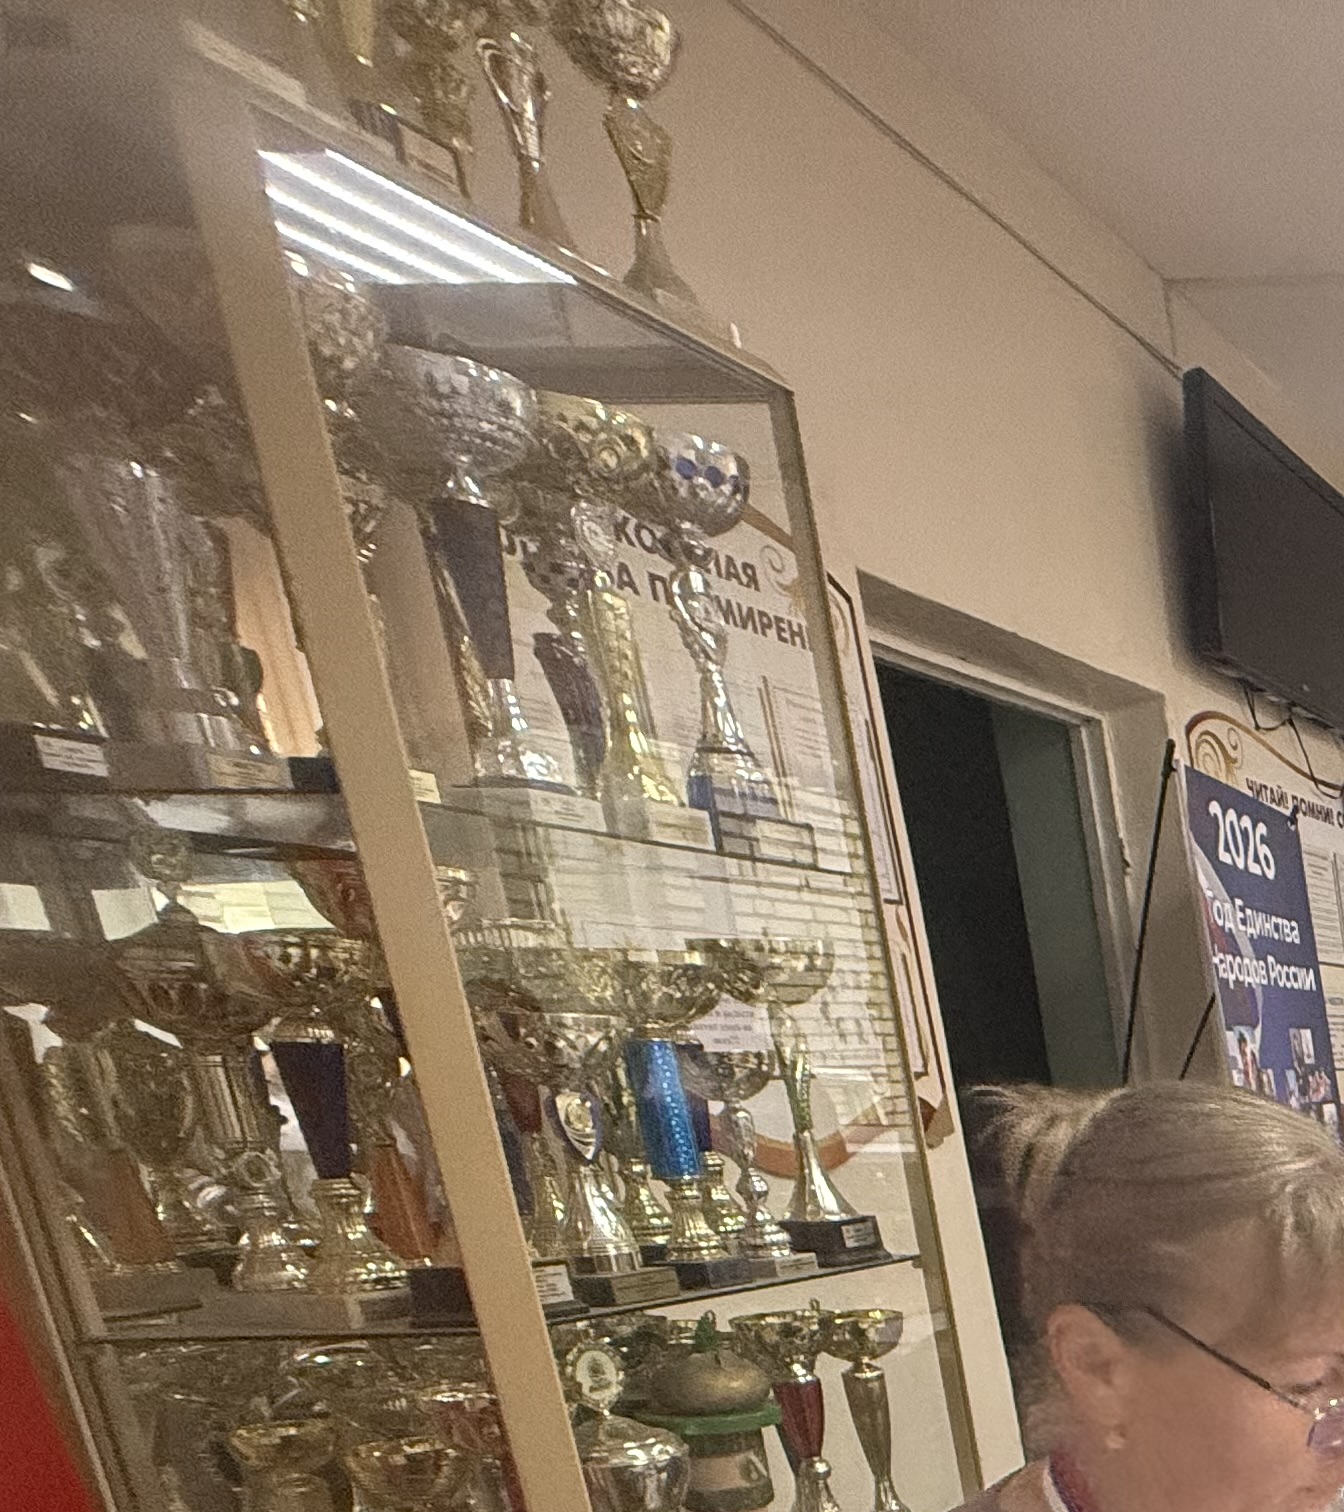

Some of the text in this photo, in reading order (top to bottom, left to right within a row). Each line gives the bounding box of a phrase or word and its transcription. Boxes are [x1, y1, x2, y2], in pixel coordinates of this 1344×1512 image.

[1246, 777, 1289, 809] ЧИТАЙ!
[1292, 794, 1335, 826] ПОМНИ!
[1208, 800, 1276, 880] 2026
[1206, 889, 1300, 944] Год Единства
[1212, 943, 1317, 992] Народов России
